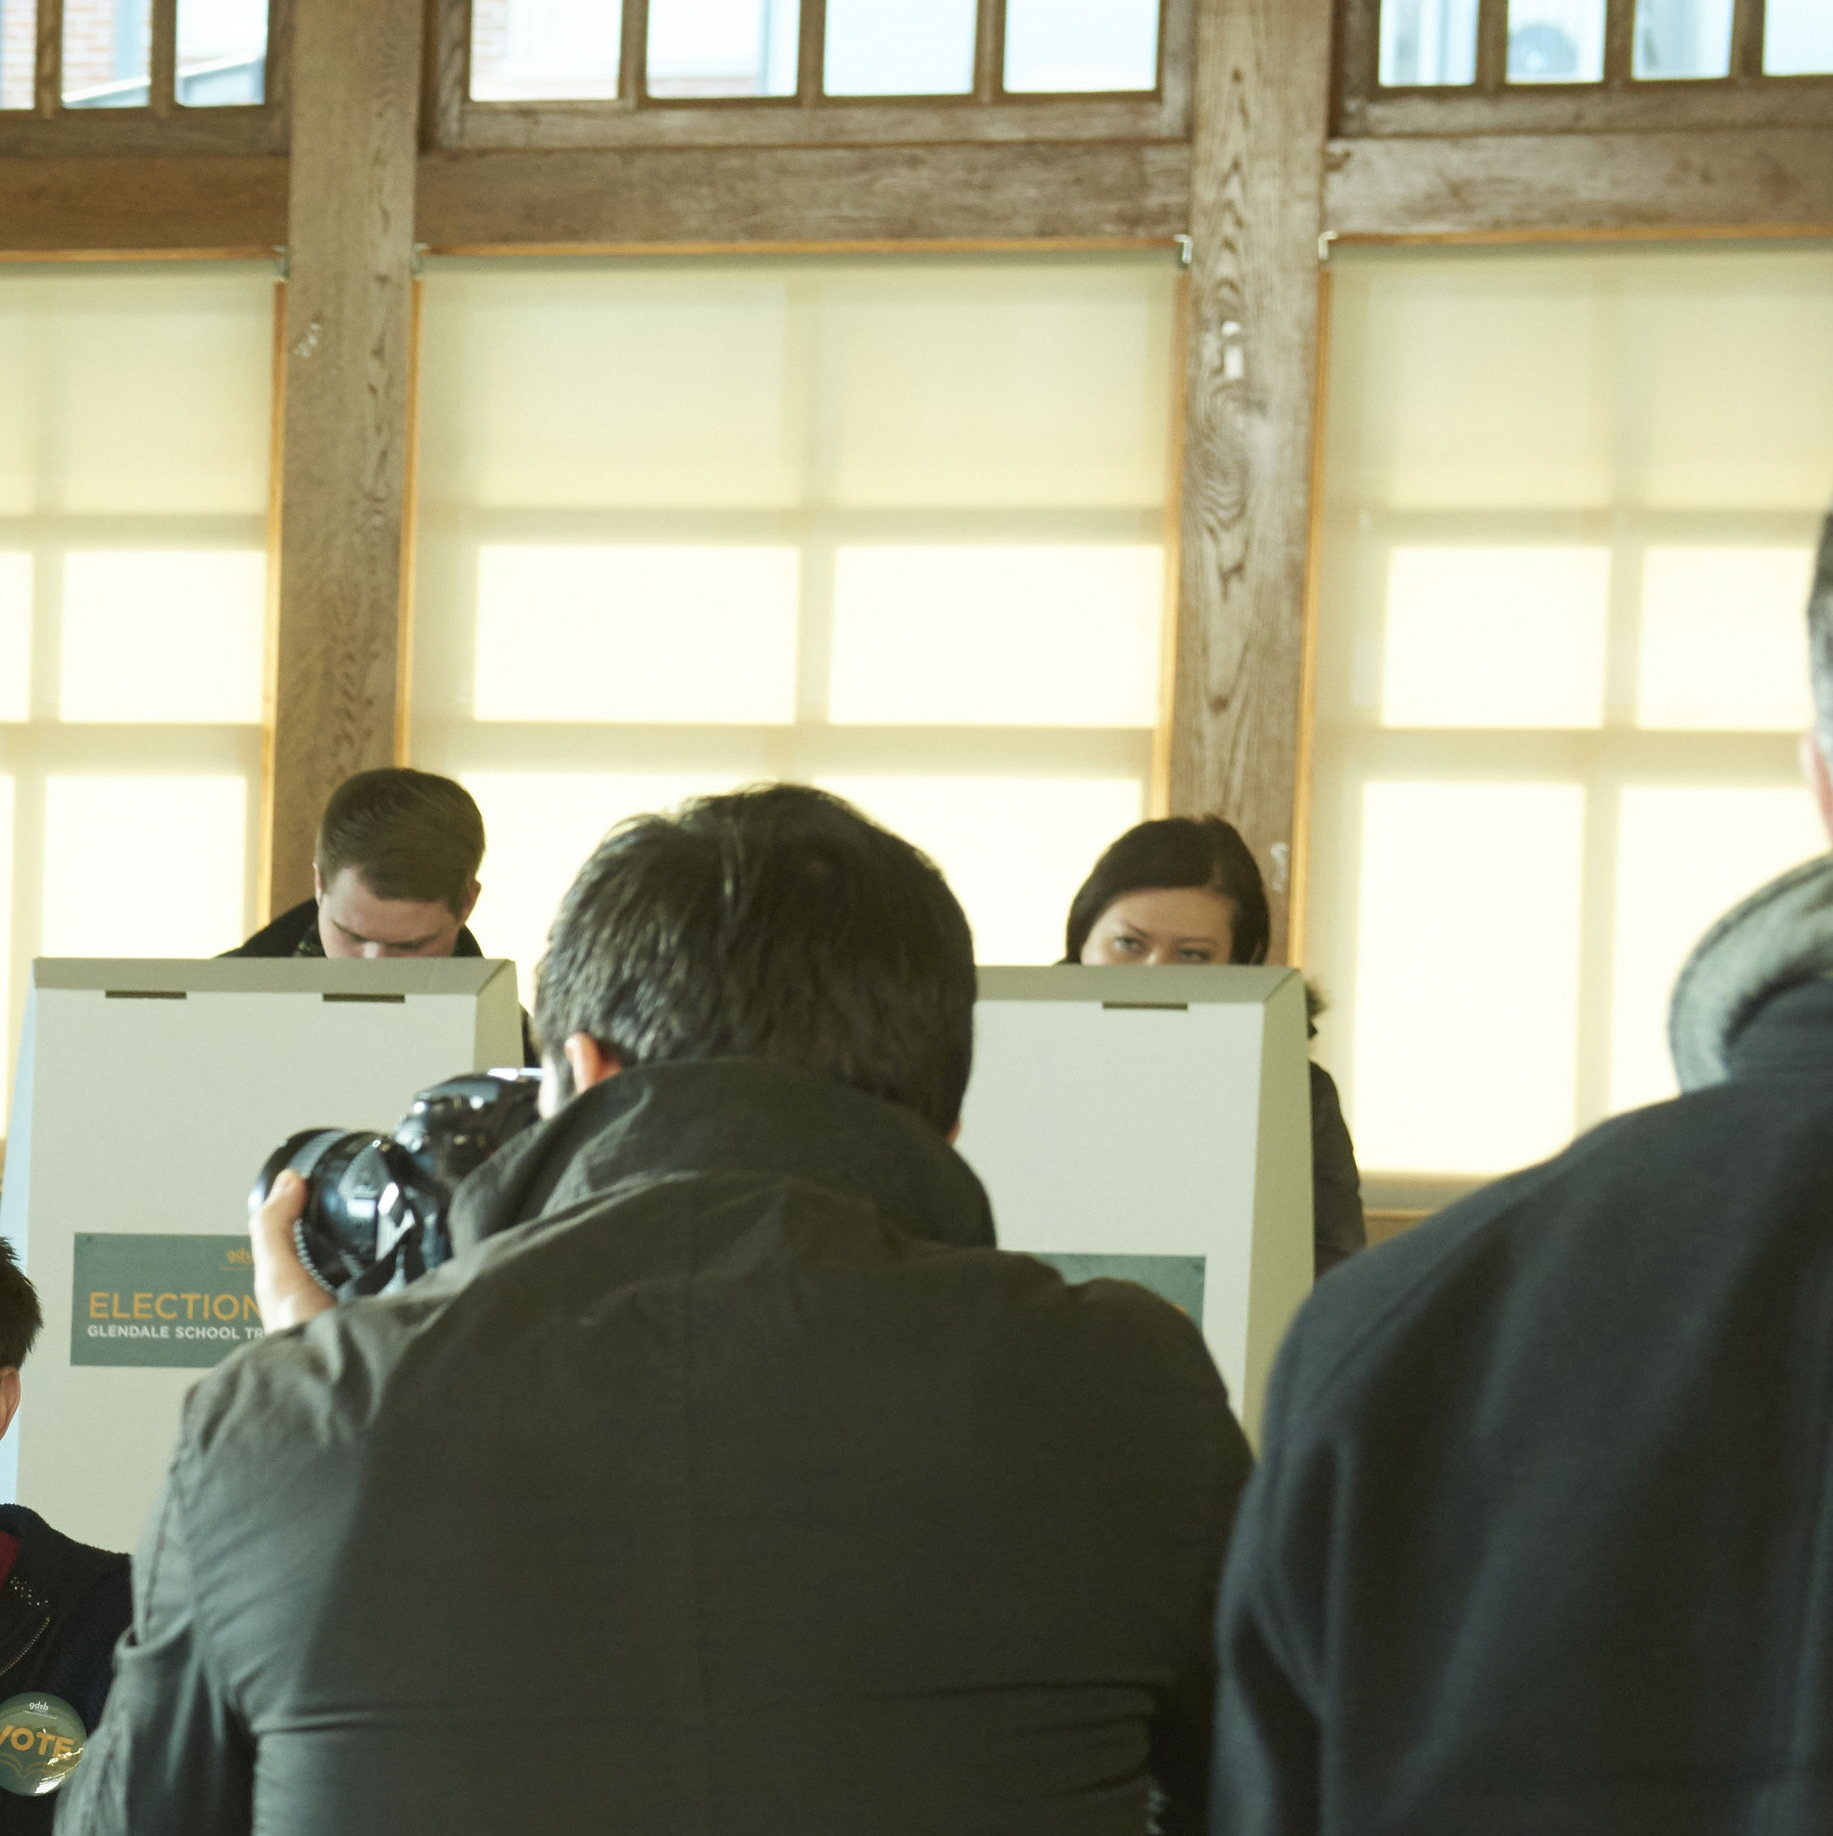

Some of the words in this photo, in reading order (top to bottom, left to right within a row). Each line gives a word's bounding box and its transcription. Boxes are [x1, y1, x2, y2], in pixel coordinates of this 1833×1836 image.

[87, 1324, 170, 1338] GLENDALE
[175, 1325, 241, 1340] SCHOOL
[29, 1701, 49, 1711] gdsb
